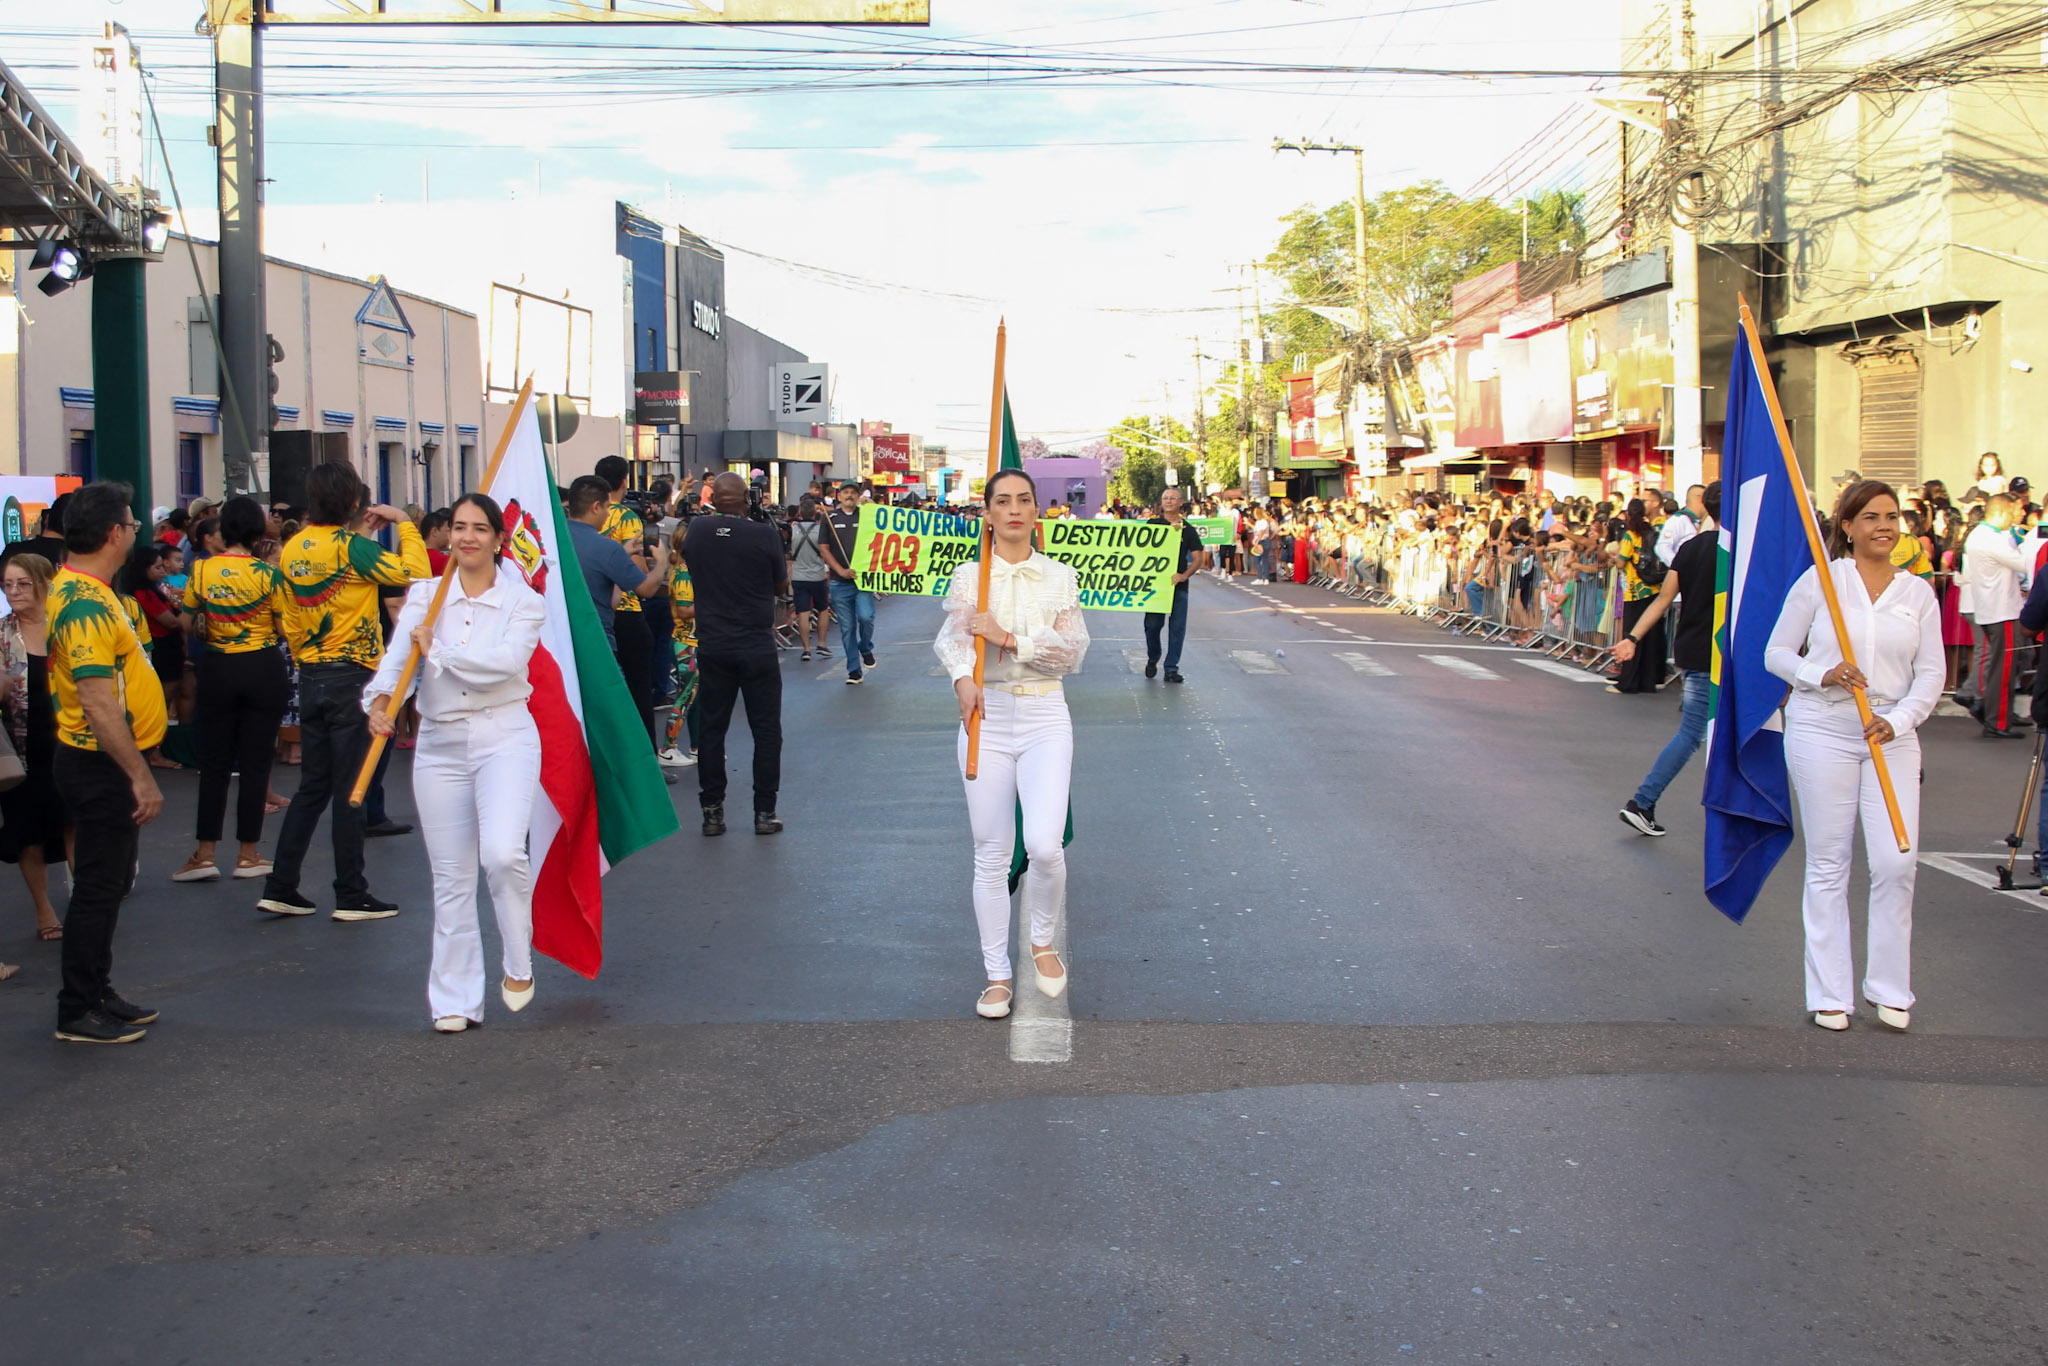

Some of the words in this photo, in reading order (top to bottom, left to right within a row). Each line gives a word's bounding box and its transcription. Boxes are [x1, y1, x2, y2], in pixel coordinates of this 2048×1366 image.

[645, 390, 689, 400] MORENA
[782, 372, 791, 414] STUDIO
[875, 507, 888, 530] O
[893, 508, 980, 539] GOVERNO
[1051, 523, 1169, 548] DESTINOU
[868, 532, 920, 574] 103
[930, 541, 977, 560] PARA
[1140, 556, 1170, 573] DO
